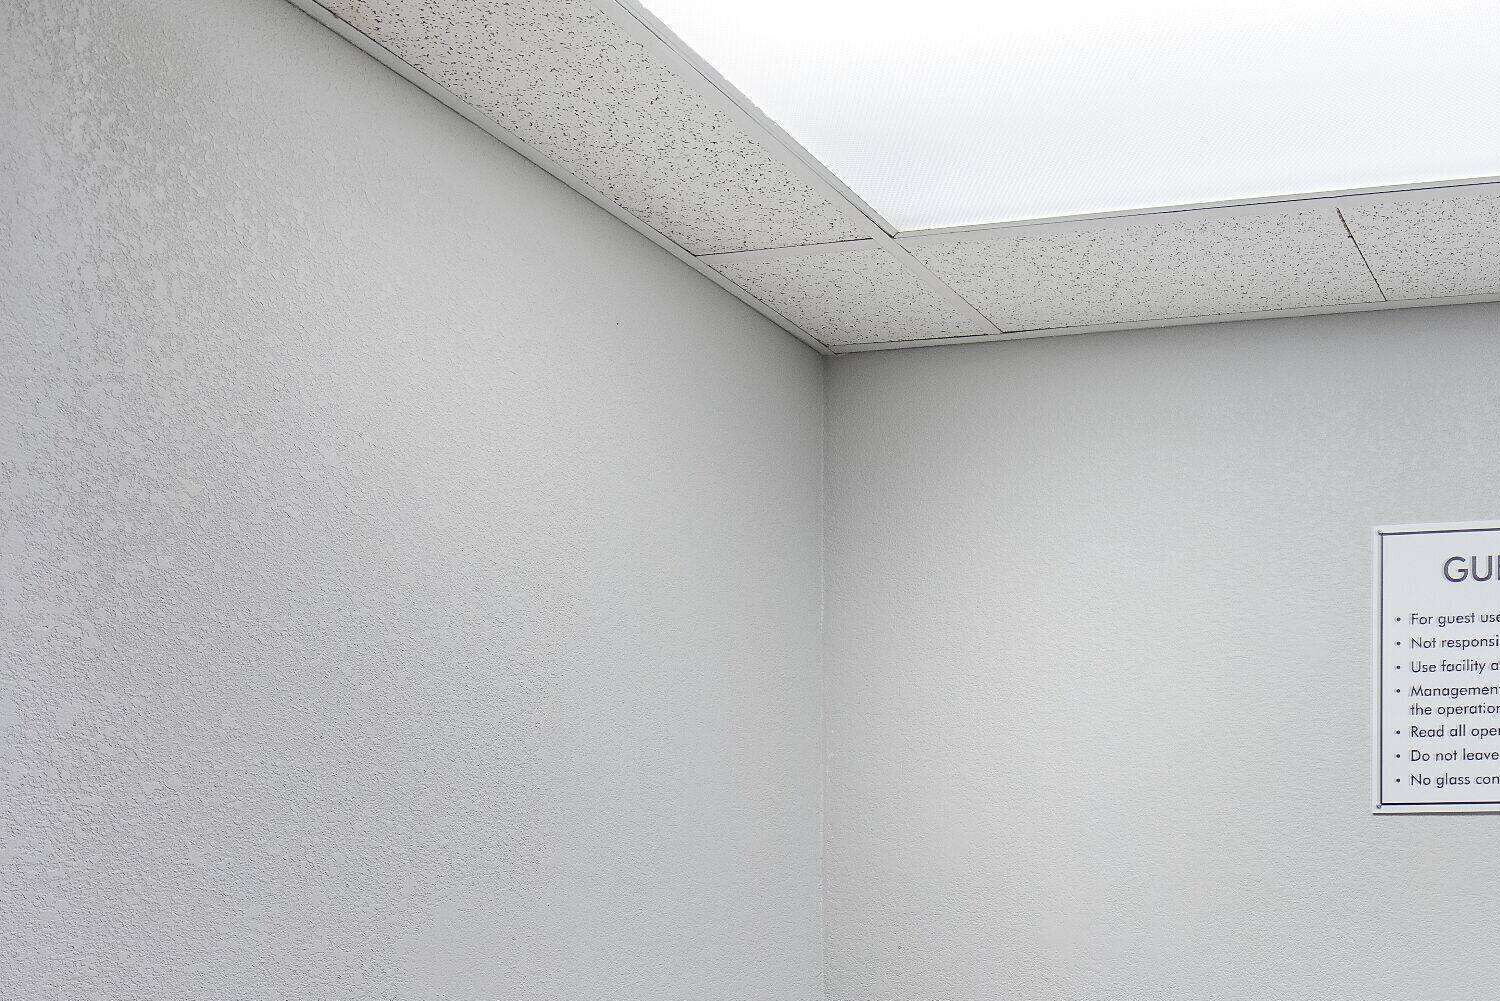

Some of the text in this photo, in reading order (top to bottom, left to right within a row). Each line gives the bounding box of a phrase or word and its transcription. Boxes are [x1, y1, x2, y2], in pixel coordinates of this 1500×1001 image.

[1411, 612, 1434, 625] For
[1438, 612, 1475, 628] guest
[1411, 637, 1436, 649] Not
[1411, 661, 1437, 673] Use
[1440, 659, 1486, 675] facility
[1410, 702, 1432, 716] the
[1411, 724, 1444, 738] Read
[1450, 724, 1466, 737] all
[1411, 749, 1430, 762] Do
[1436, 750, 1458, 762] not
[1463, 748, 1500, 761] leave
[1410, 774, 1432, 786] No
[1436, 772, 1471, 789] glass
